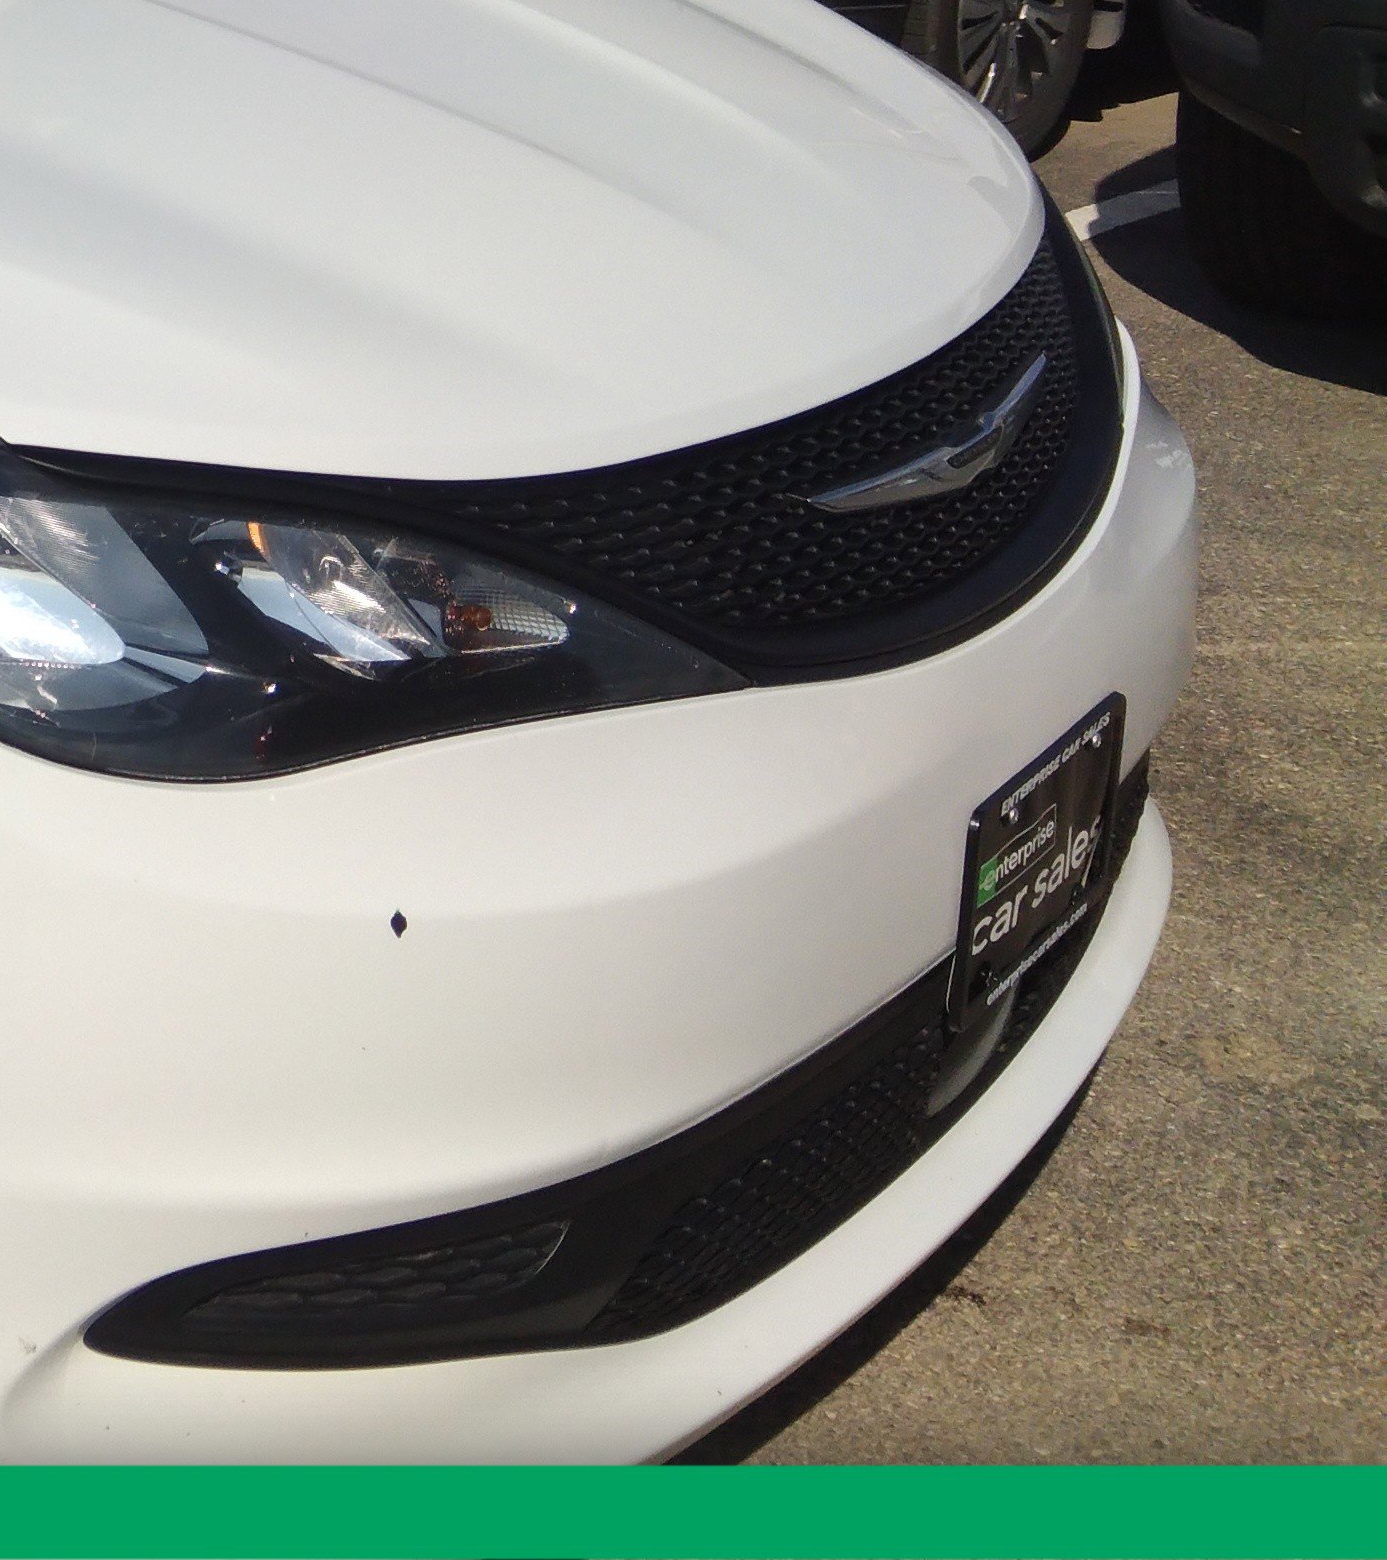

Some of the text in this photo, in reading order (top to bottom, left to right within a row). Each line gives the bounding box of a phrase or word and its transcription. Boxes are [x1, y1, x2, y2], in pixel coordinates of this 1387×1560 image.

[972, 815, 1102, 955] car sales
[980, 820, 1055, 891] enterprise
